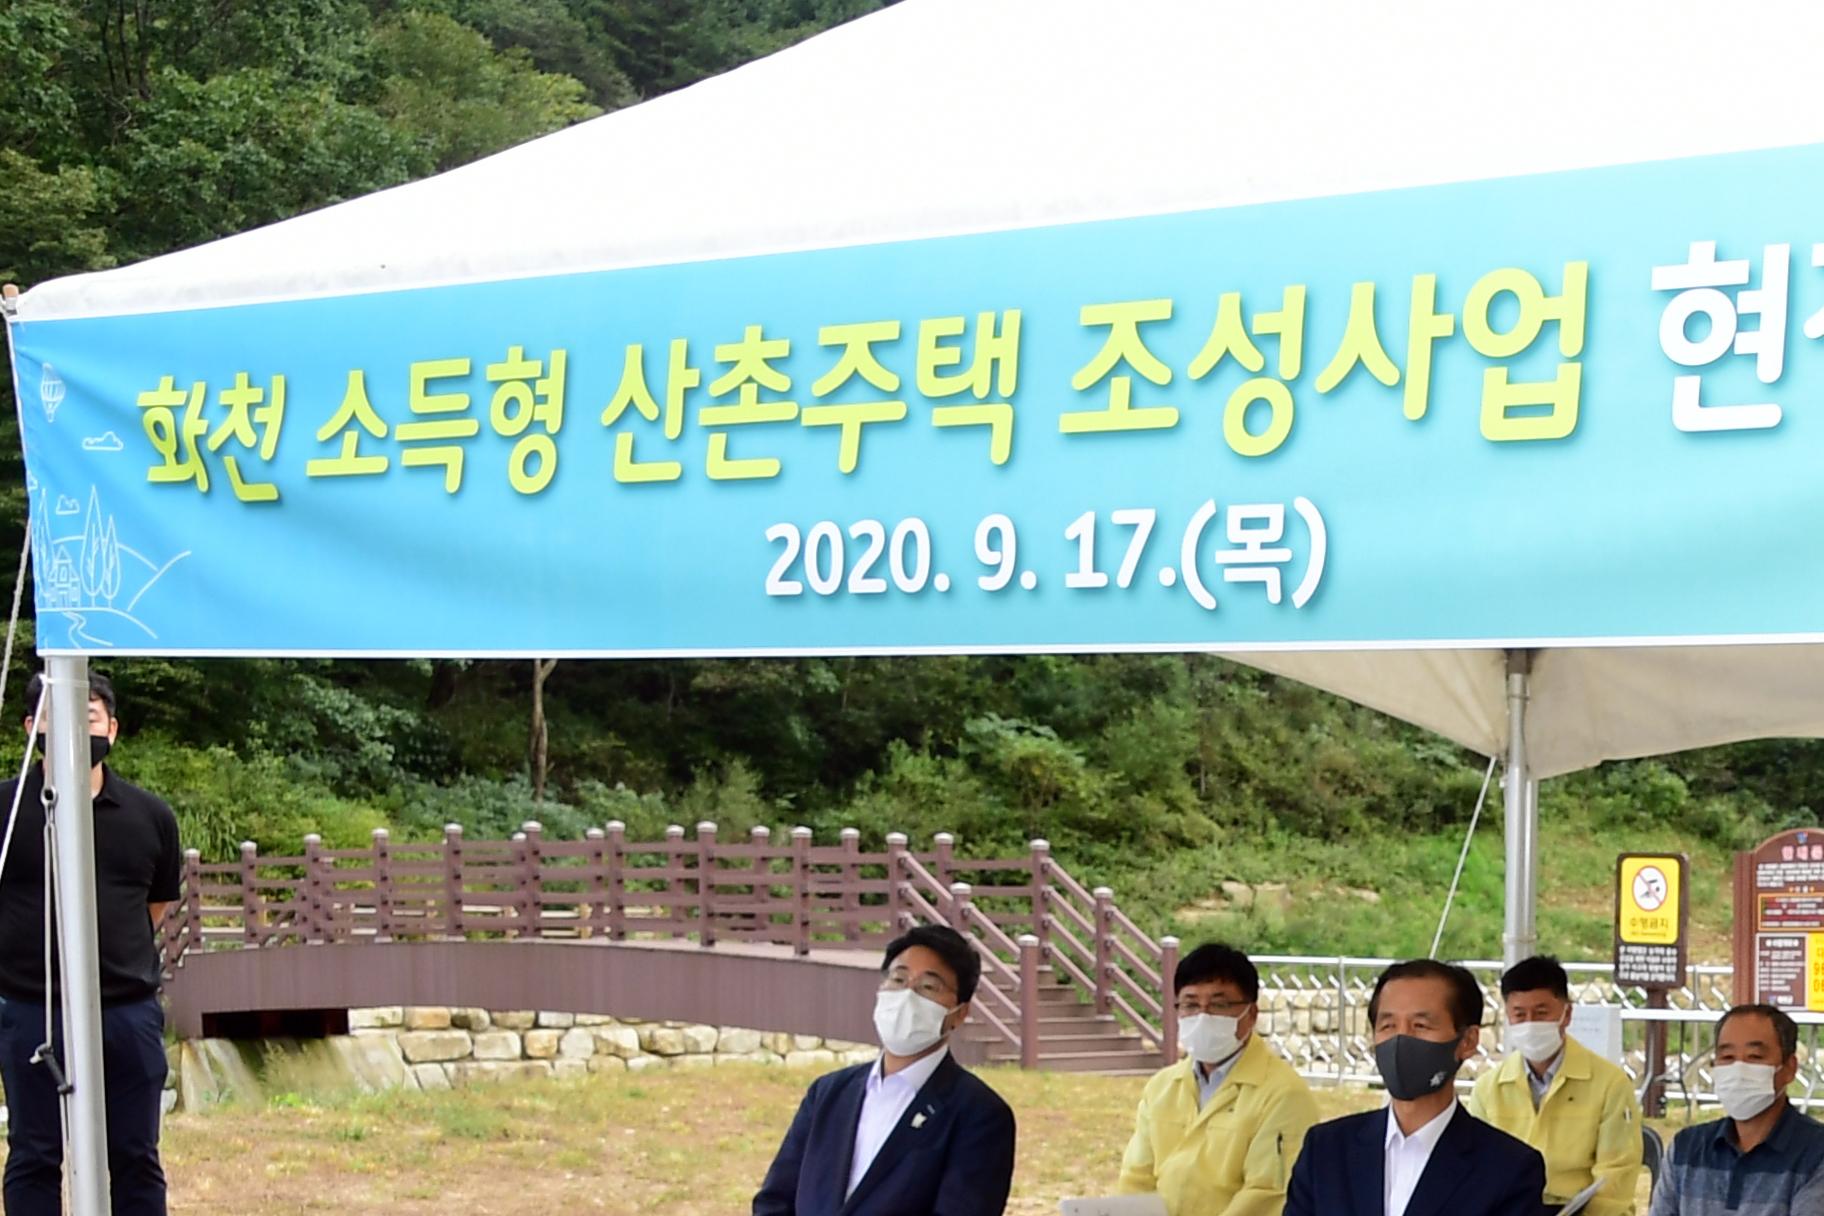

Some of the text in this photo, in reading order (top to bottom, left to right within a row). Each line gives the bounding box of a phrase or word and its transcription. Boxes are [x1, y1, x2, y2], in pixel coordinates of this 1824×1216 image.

[136, 371, 286, 502] 화천
[306, 345, 567, 494] 소득형
[601, 309, 1021, 483] 산촌주택
[1058, 261, 1588, 457] 조성사업
[764, 517, 950, 596] 2020.
[974, 513, 1038, 591] 9.
